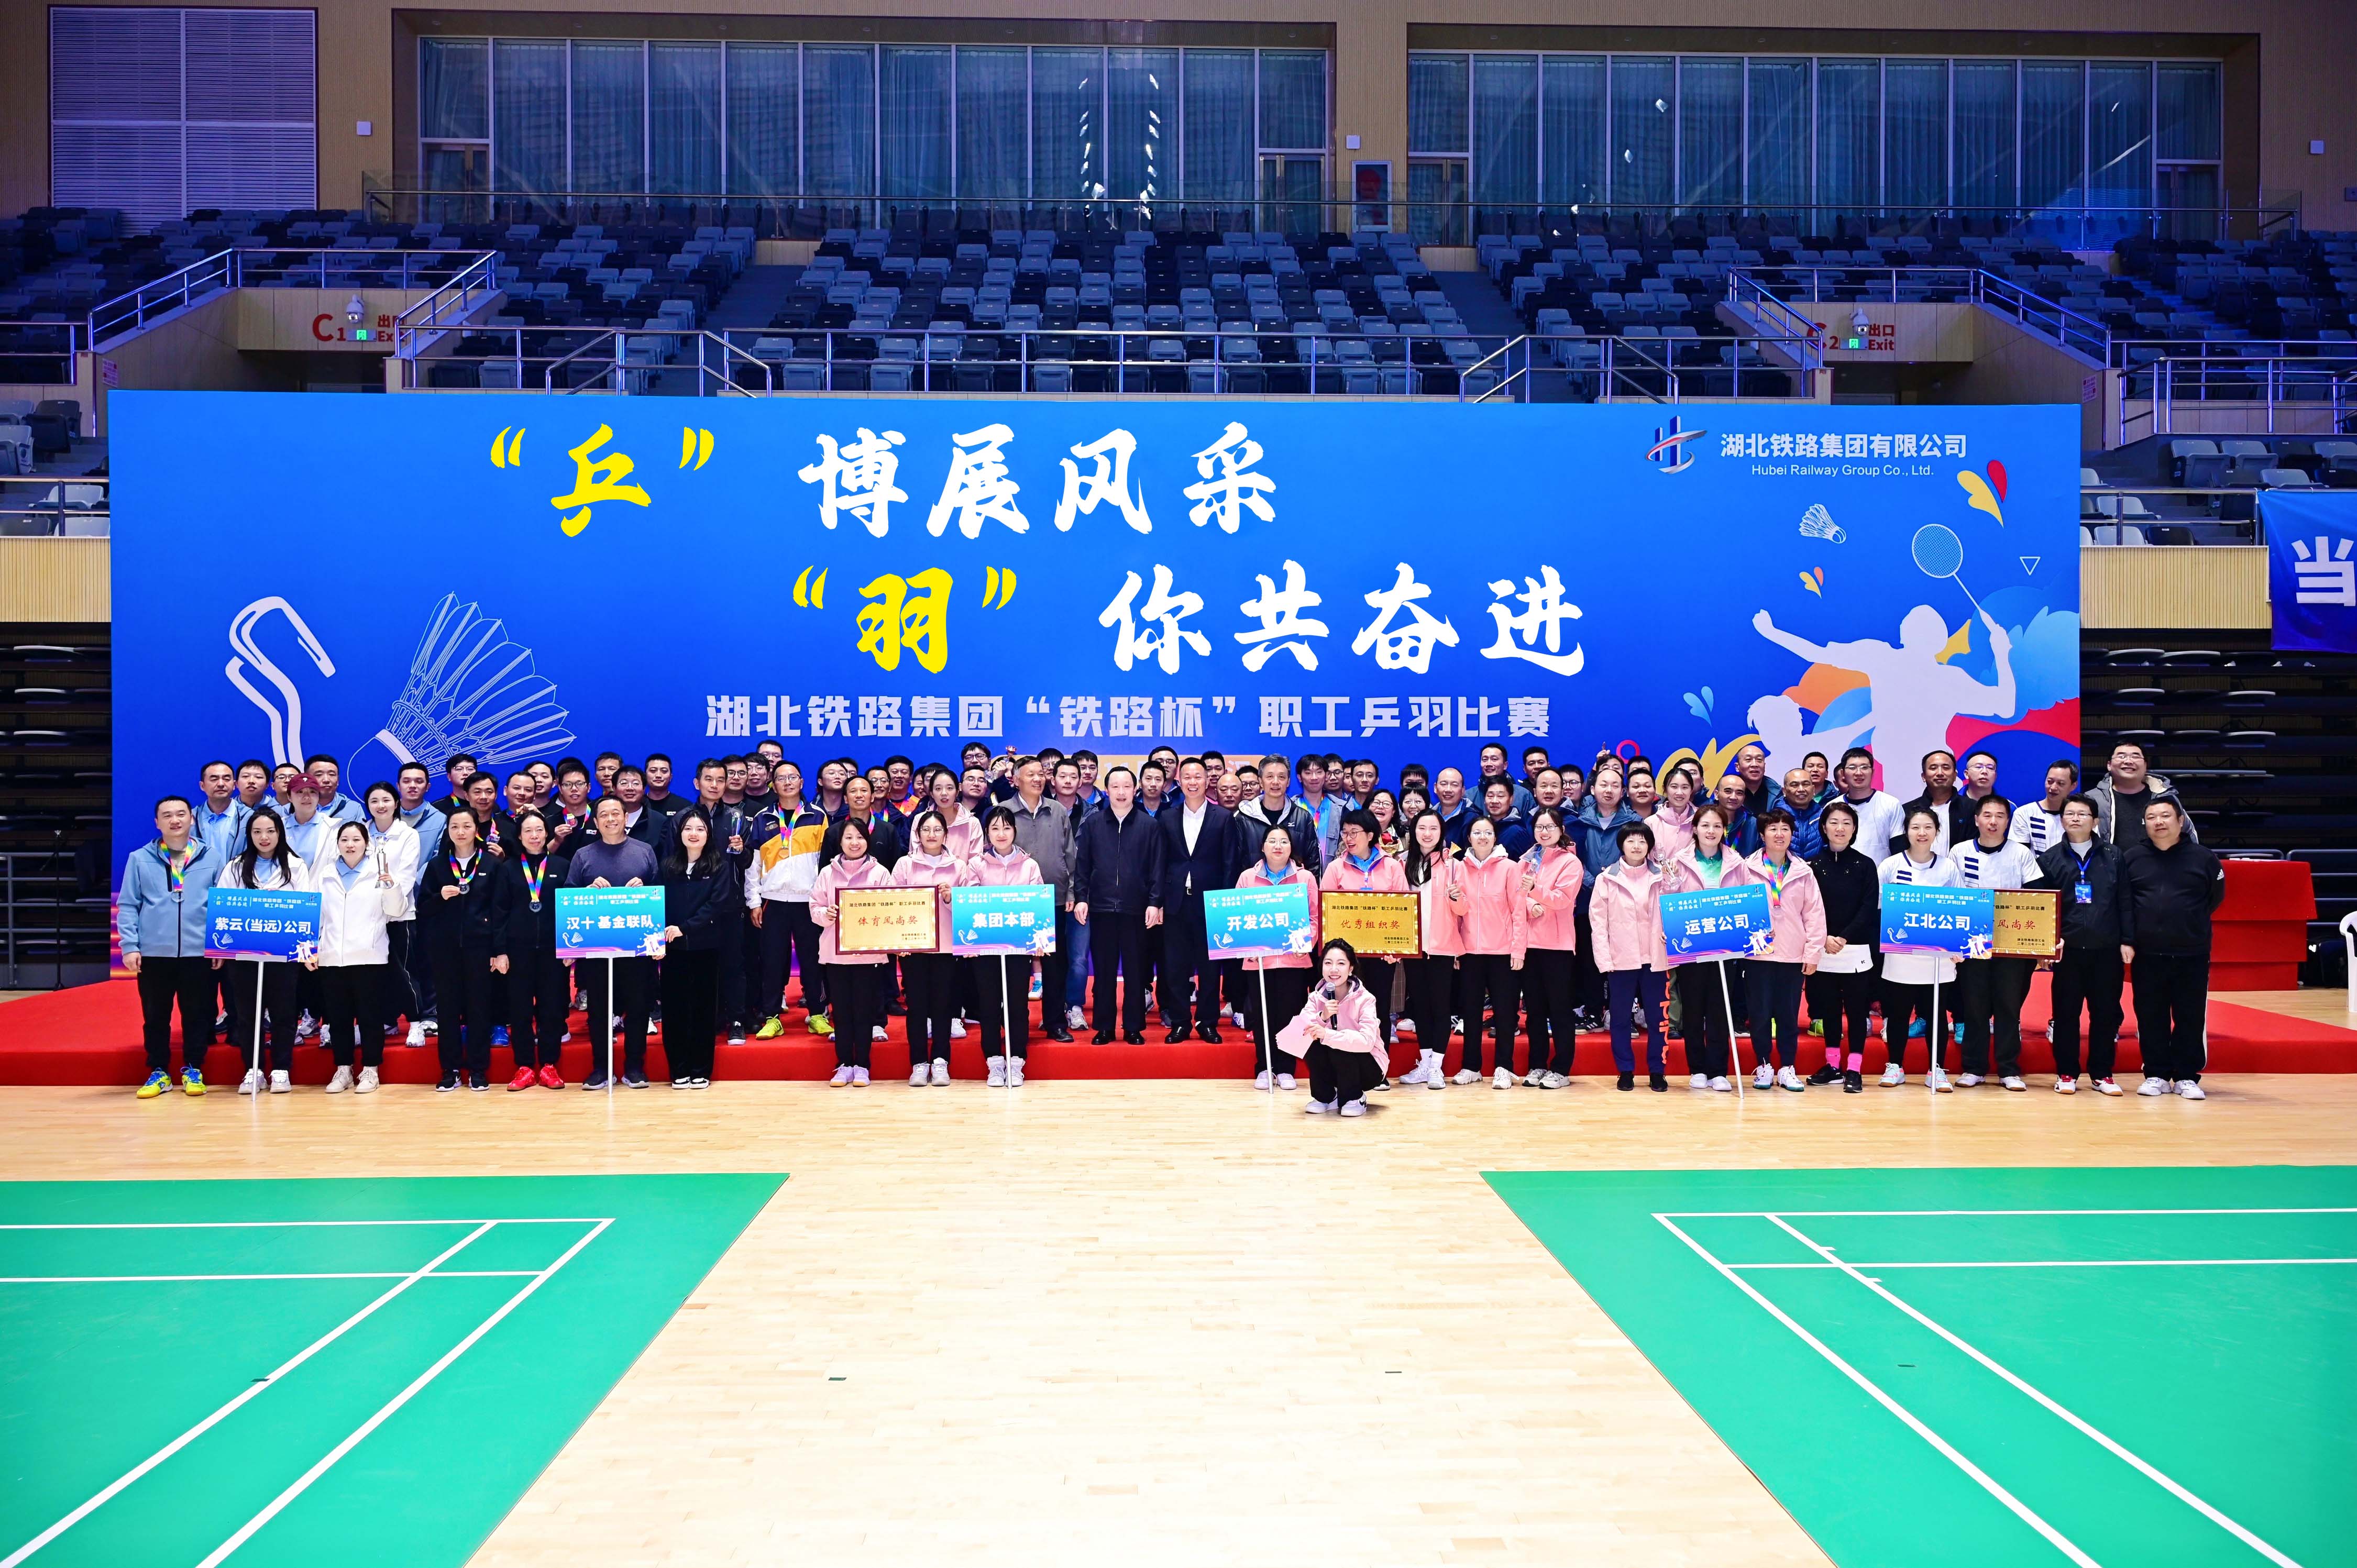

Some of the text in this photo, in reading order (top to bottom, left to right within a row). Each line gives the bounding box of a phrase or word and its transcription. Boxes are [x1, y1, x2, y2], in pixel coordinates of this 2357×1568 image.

[313, 313, 346, 341] C1
[1868, 323, 1895, 337] 出口
[1868, 339, 1895, 350] Exit
[1721, 433, 1967, 458] 湖北铁路集团有限公司
[798, 421, 1276, 539] 博展风采
[1752, 465, 1787, 476] Hubei
[1790, 465, 1838, 478] Railway
[1842, 465, 1880, 478] Group
[1911, 465, 1934, 476] Ltd.
[2292, 536, 2356, 606] 当
[1098, 559, 1584, 677] 你共奋进
[566, 914, 654, 930] 汉十基金联队
[857, 915, 918, 926] 体育风尚奖
[973, 912, 1035, 928] 集团本部
[1227, 912, 1289, 932] 开发公司
[1341, 919, 1400, 930] 优秀组织奖
[1684, 913, 1749, 935] 运营公司
[1903, 912, 1970, 931] 江北公司
[1996, 919, 2035, 930] 风尚奖
